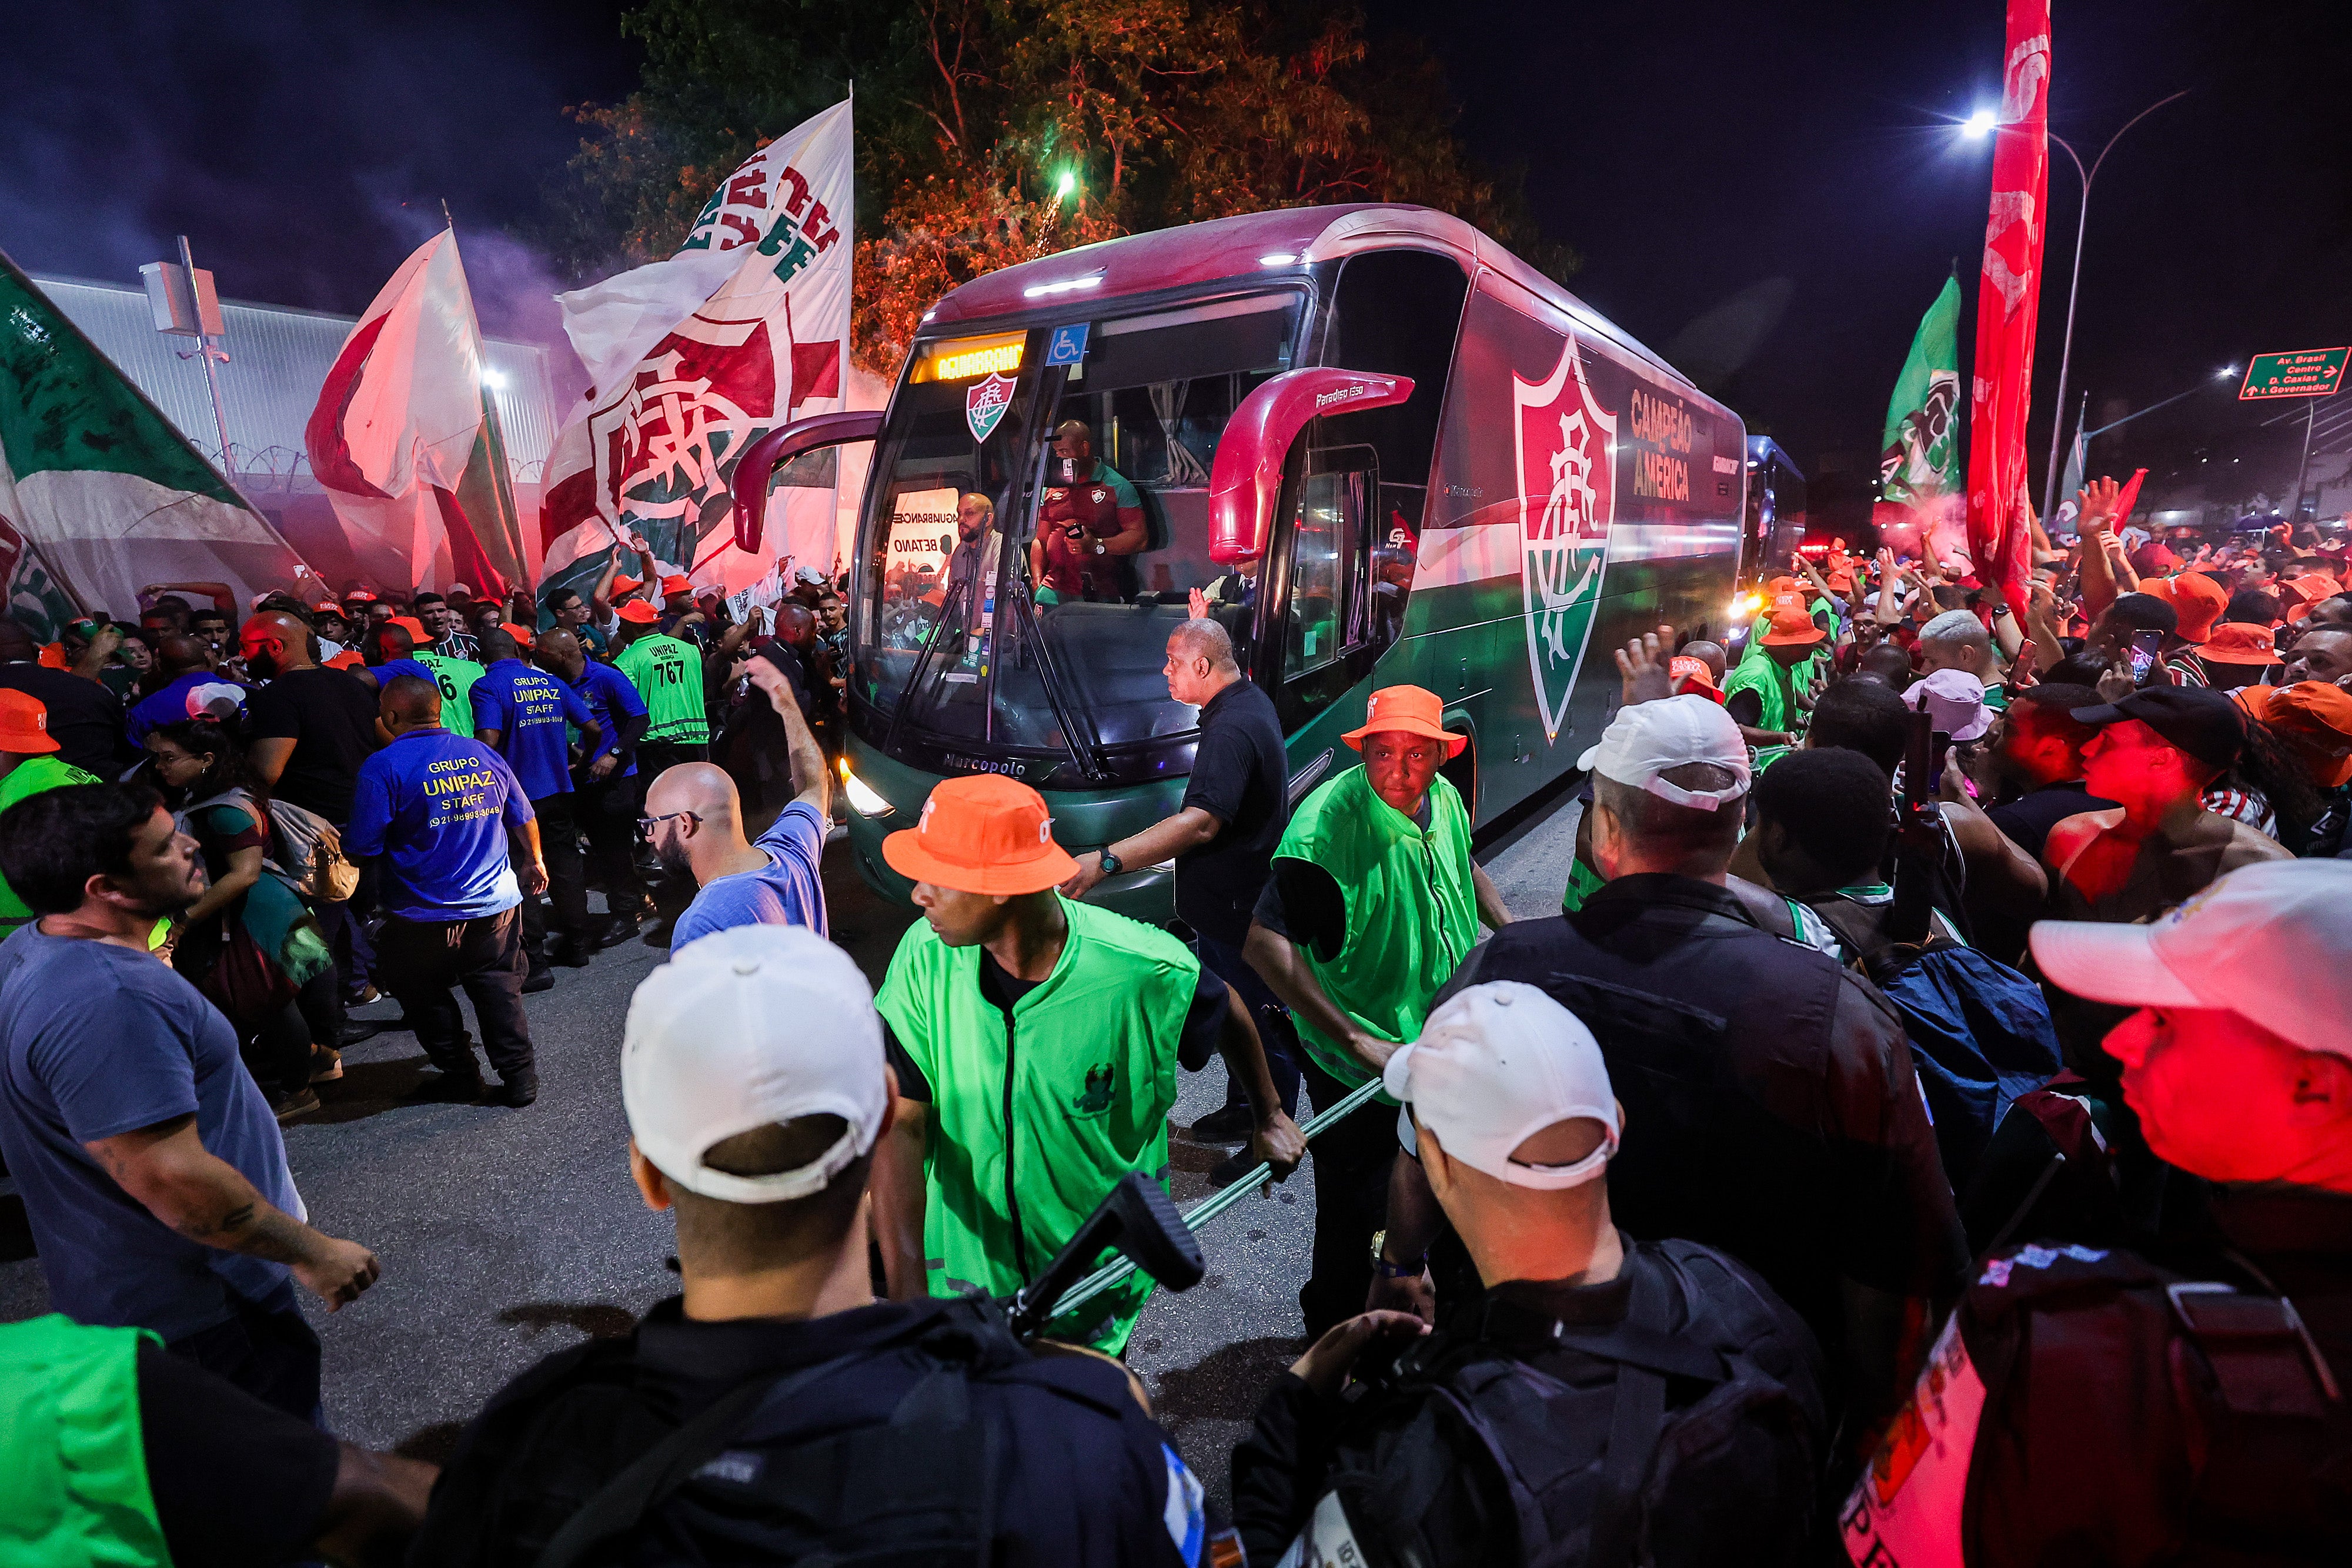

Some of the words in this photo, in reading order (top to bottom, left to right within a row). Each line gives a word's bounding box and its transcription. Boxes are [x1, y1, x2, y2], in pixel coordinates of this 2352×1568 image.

[2295, 354, 2327, 364] Brasil
[2286, 366, 2322, 374] Centro
[2283, 375, 2318, 384] Caxias
[2269, 383, 2330, 394] Governador
[1316, 389, 1348, 408] Paradiso
[649, 644, 678, 657] UNIPAZ
[653, 660, 684, 687] 767
[514, 677, 549, 686] GRUPO
[513, 688, 560, 703] UNIPAZ
[526, 704, 553, 714] STAFF
[429, 757, 479, 773] GRUPO
[944, 754, 1025, 775] Marcopolo
[423, 770, 495, 796] UNIPAZ
[442, 793, 485, 810] STAFF
